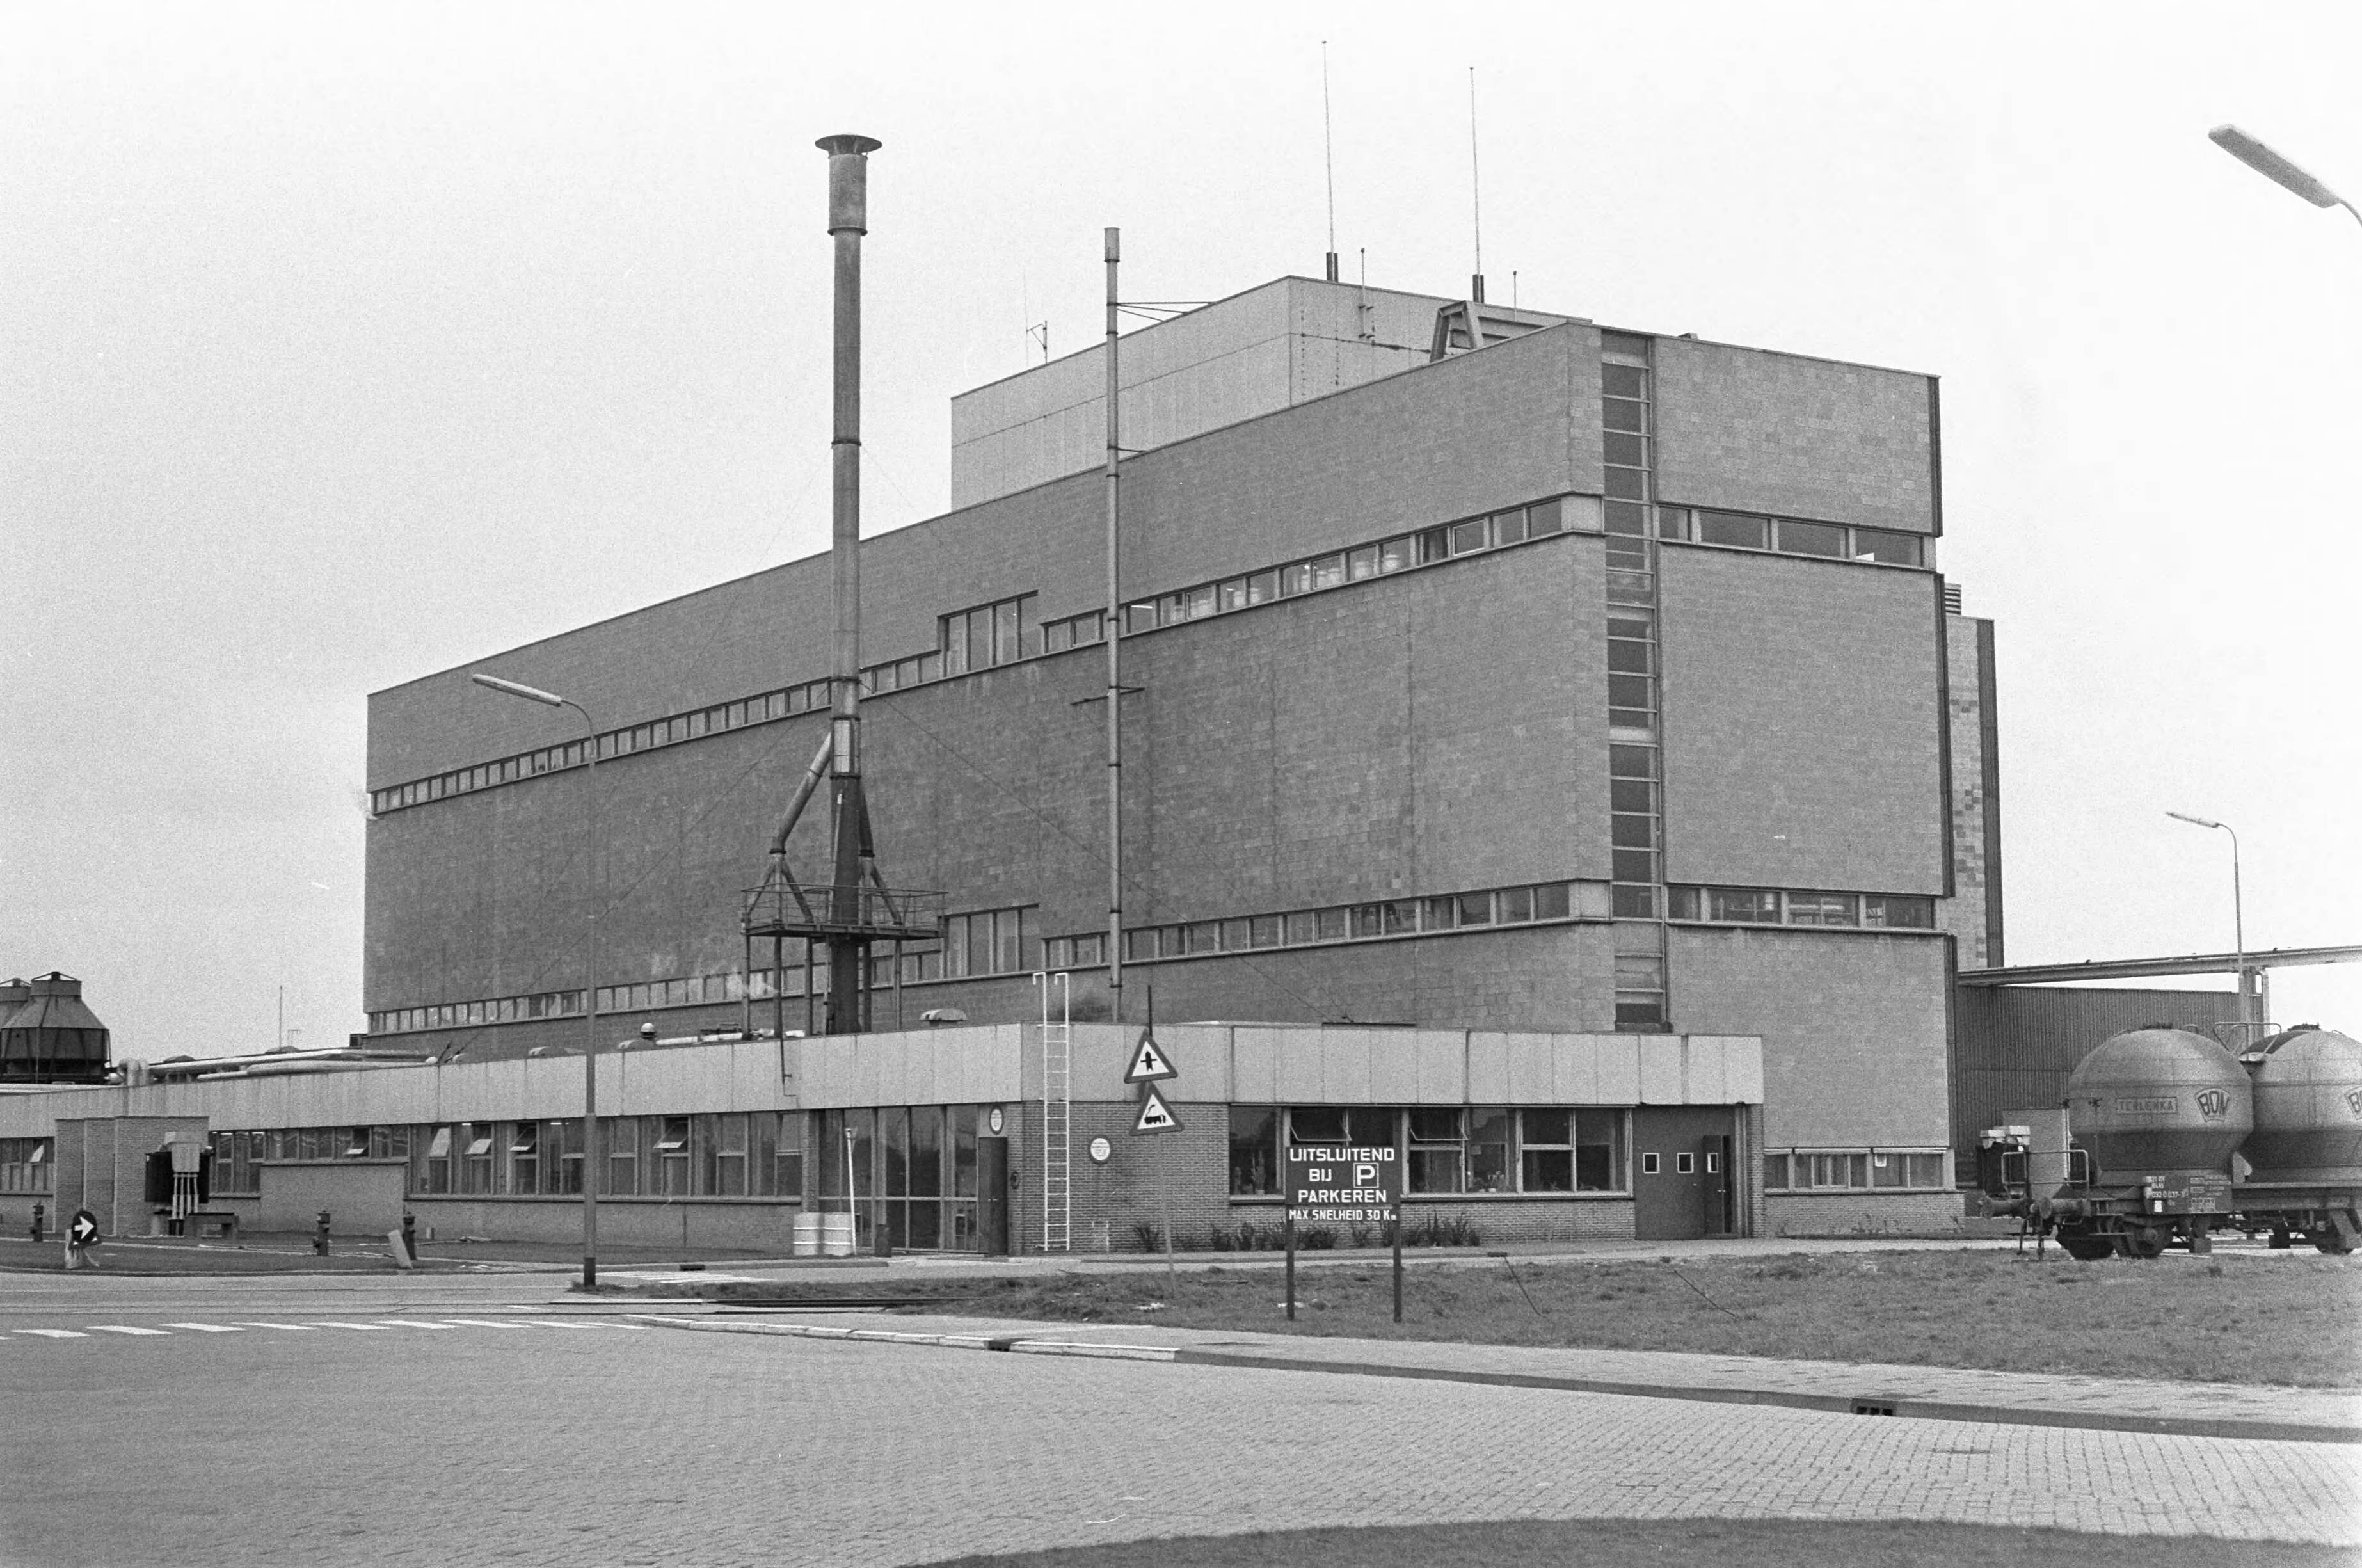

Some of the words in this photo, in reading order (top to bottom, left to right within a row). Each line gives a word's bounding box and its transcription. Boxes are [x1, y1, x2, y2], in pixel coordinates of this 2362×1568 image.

[2197, 1090, 2230, 1116] BON
[1289, 1148, 1395, 1162] UITSLUITEND
[1309, 1168, 1332, 1181] BIJ
[1356, 1165, 1376, 1186] P
[1298, 1189, 1387, 1203] PARKEREN
[1312, 1209, 1363, 1220] SNELHEID
[1366, 1209, 1380, 1220] 30
